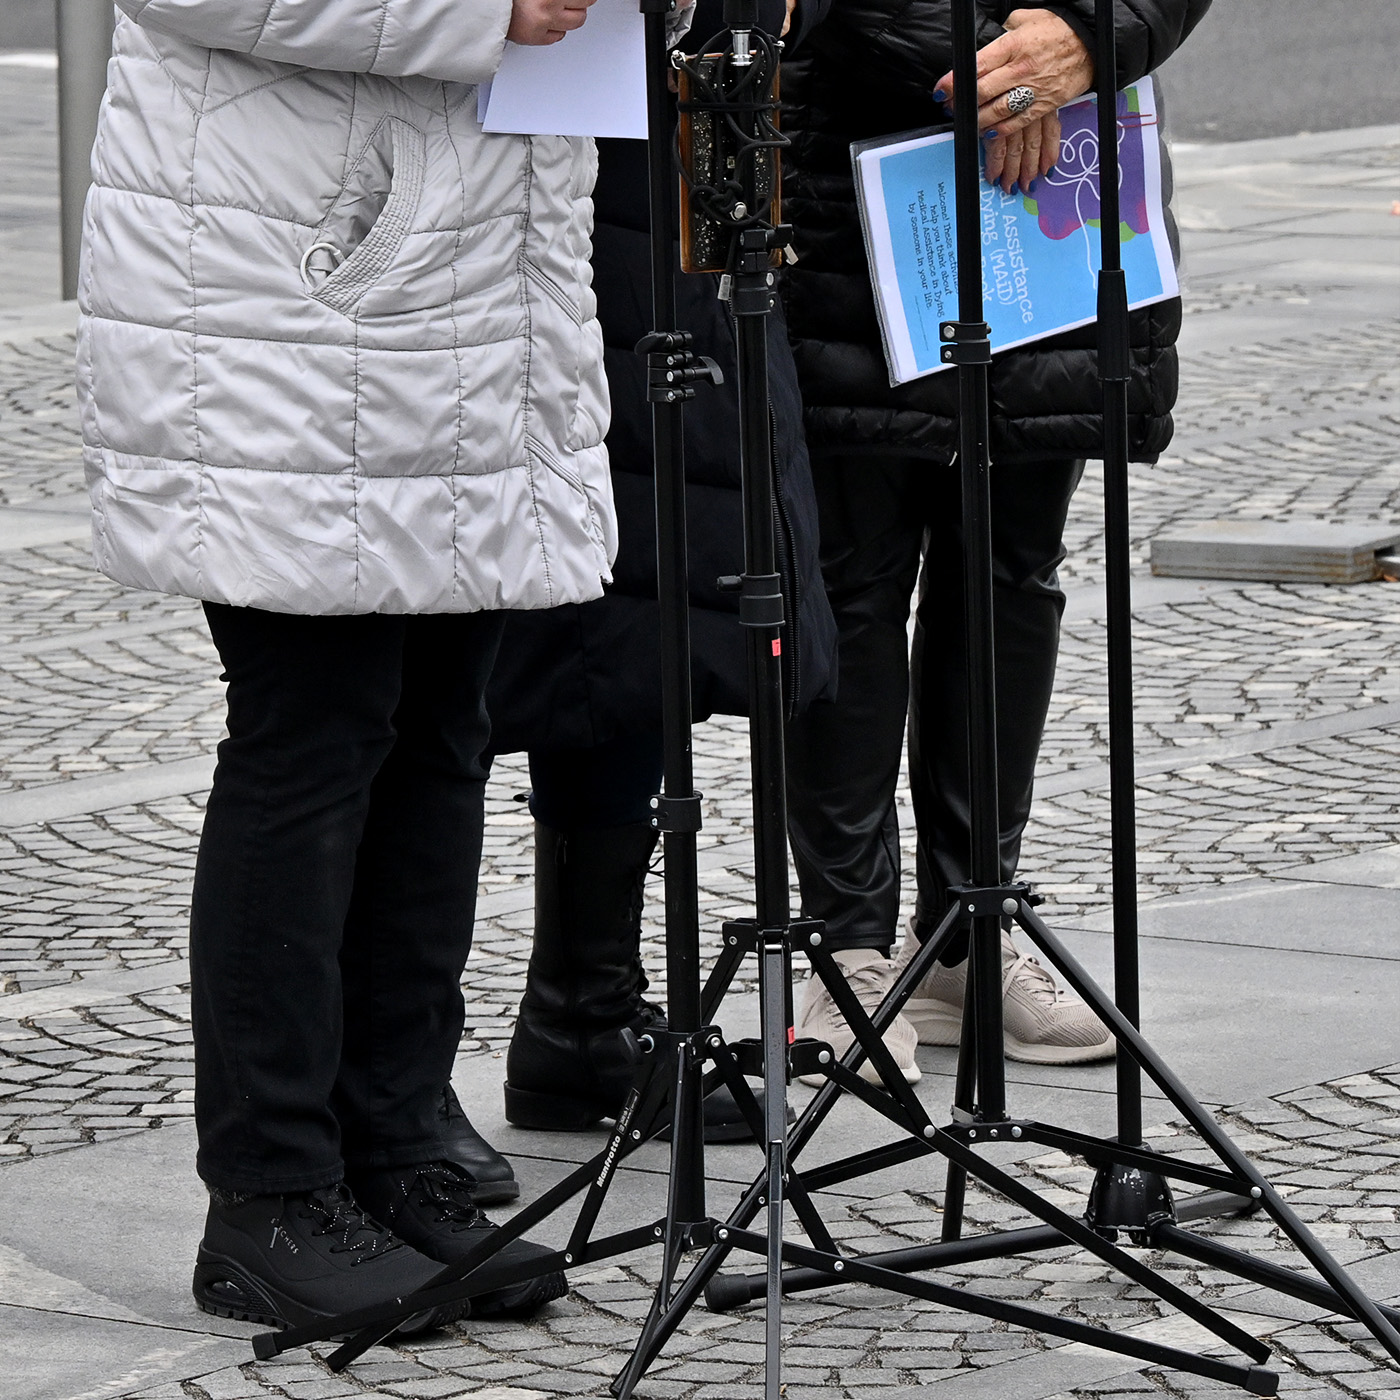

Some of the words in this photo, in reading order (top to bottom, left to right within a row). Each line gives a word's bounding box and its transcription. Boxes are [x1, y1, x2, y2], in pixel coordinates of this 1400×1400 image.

[908, 202, 915, 213] by
[918, 266, 928, 290] your
[938, 182, 948, 222] Welcome!
[944, 223, 952, 248] These
[917, 190, 925, 225] Medical
[923, 227, 936, 277] Assistance
[934, 291, 944, 318] Dying
[936, 244, 947, 269] think
[941, 270, 952, 295] about
[1002, 215, 1033, 323] Assistance
[597, 1135, 621, 1187] Manfrotto
